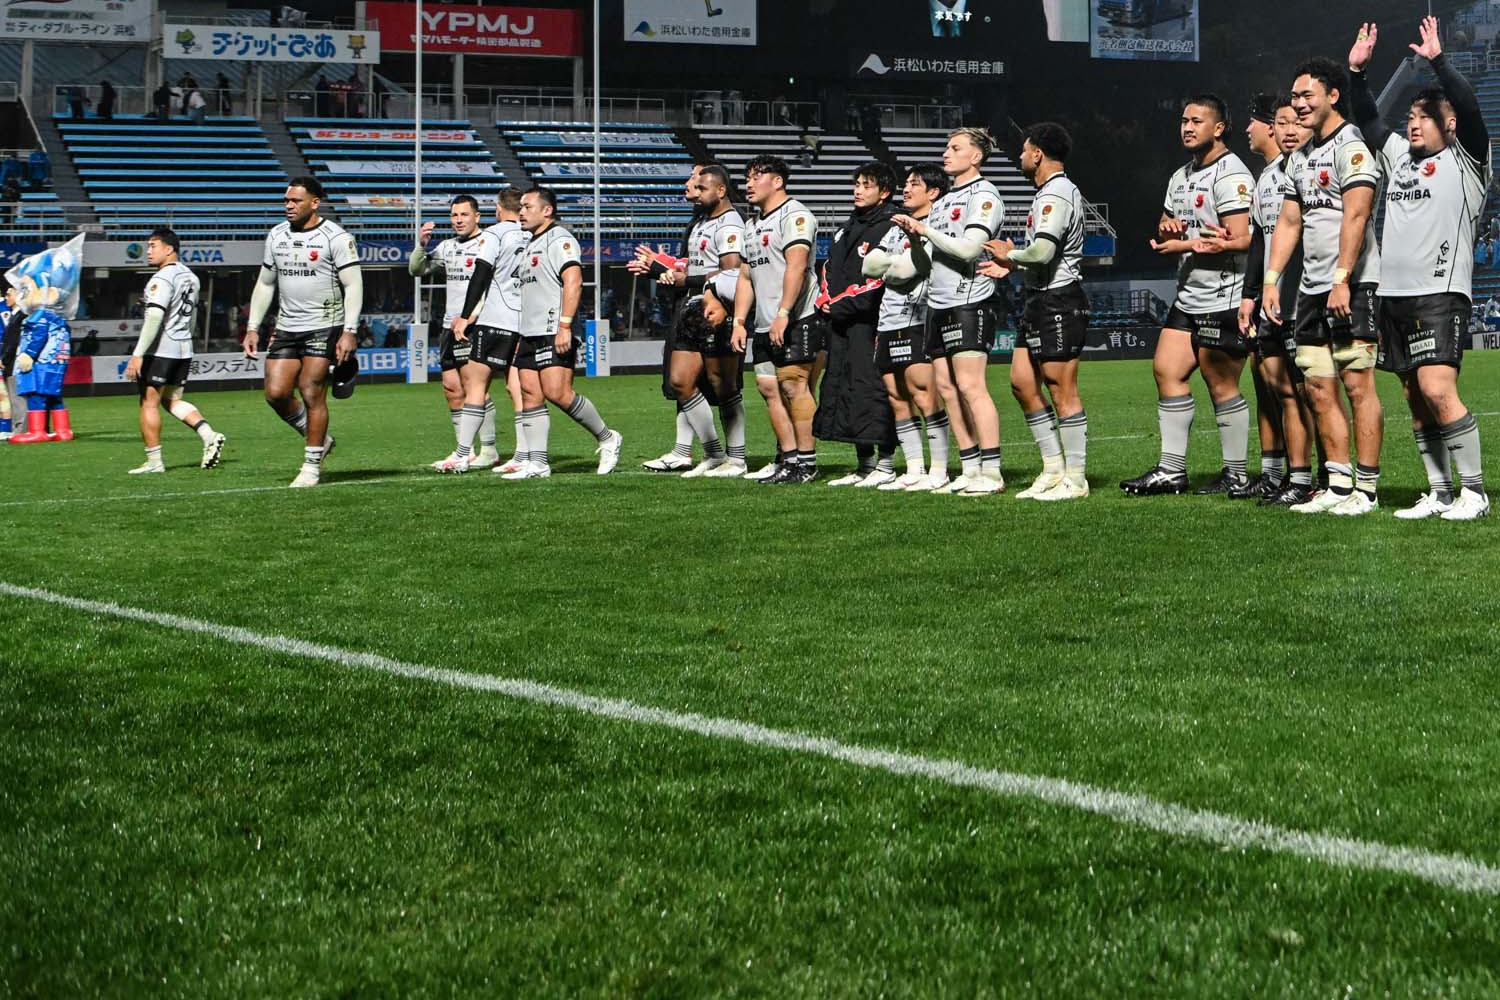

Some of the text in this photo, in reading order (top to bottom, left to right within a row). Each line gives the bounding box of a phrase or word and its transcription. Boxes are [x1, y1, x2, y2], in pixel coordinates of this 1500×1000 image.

[421, 12, 535, 35] YPMJ
[660, 24, 752, 39] 浜松いわた信用金庫
[211, 32, 337, 59] チケットぴあ
[893, 57, 1006, 75] 浜松いわた信用金庫
[1386, 188, 1431, 202] TOSHIBA
[279, 268, 317, 277] TOSHIBA
[1108, 330, 1146, 348] 育む。
